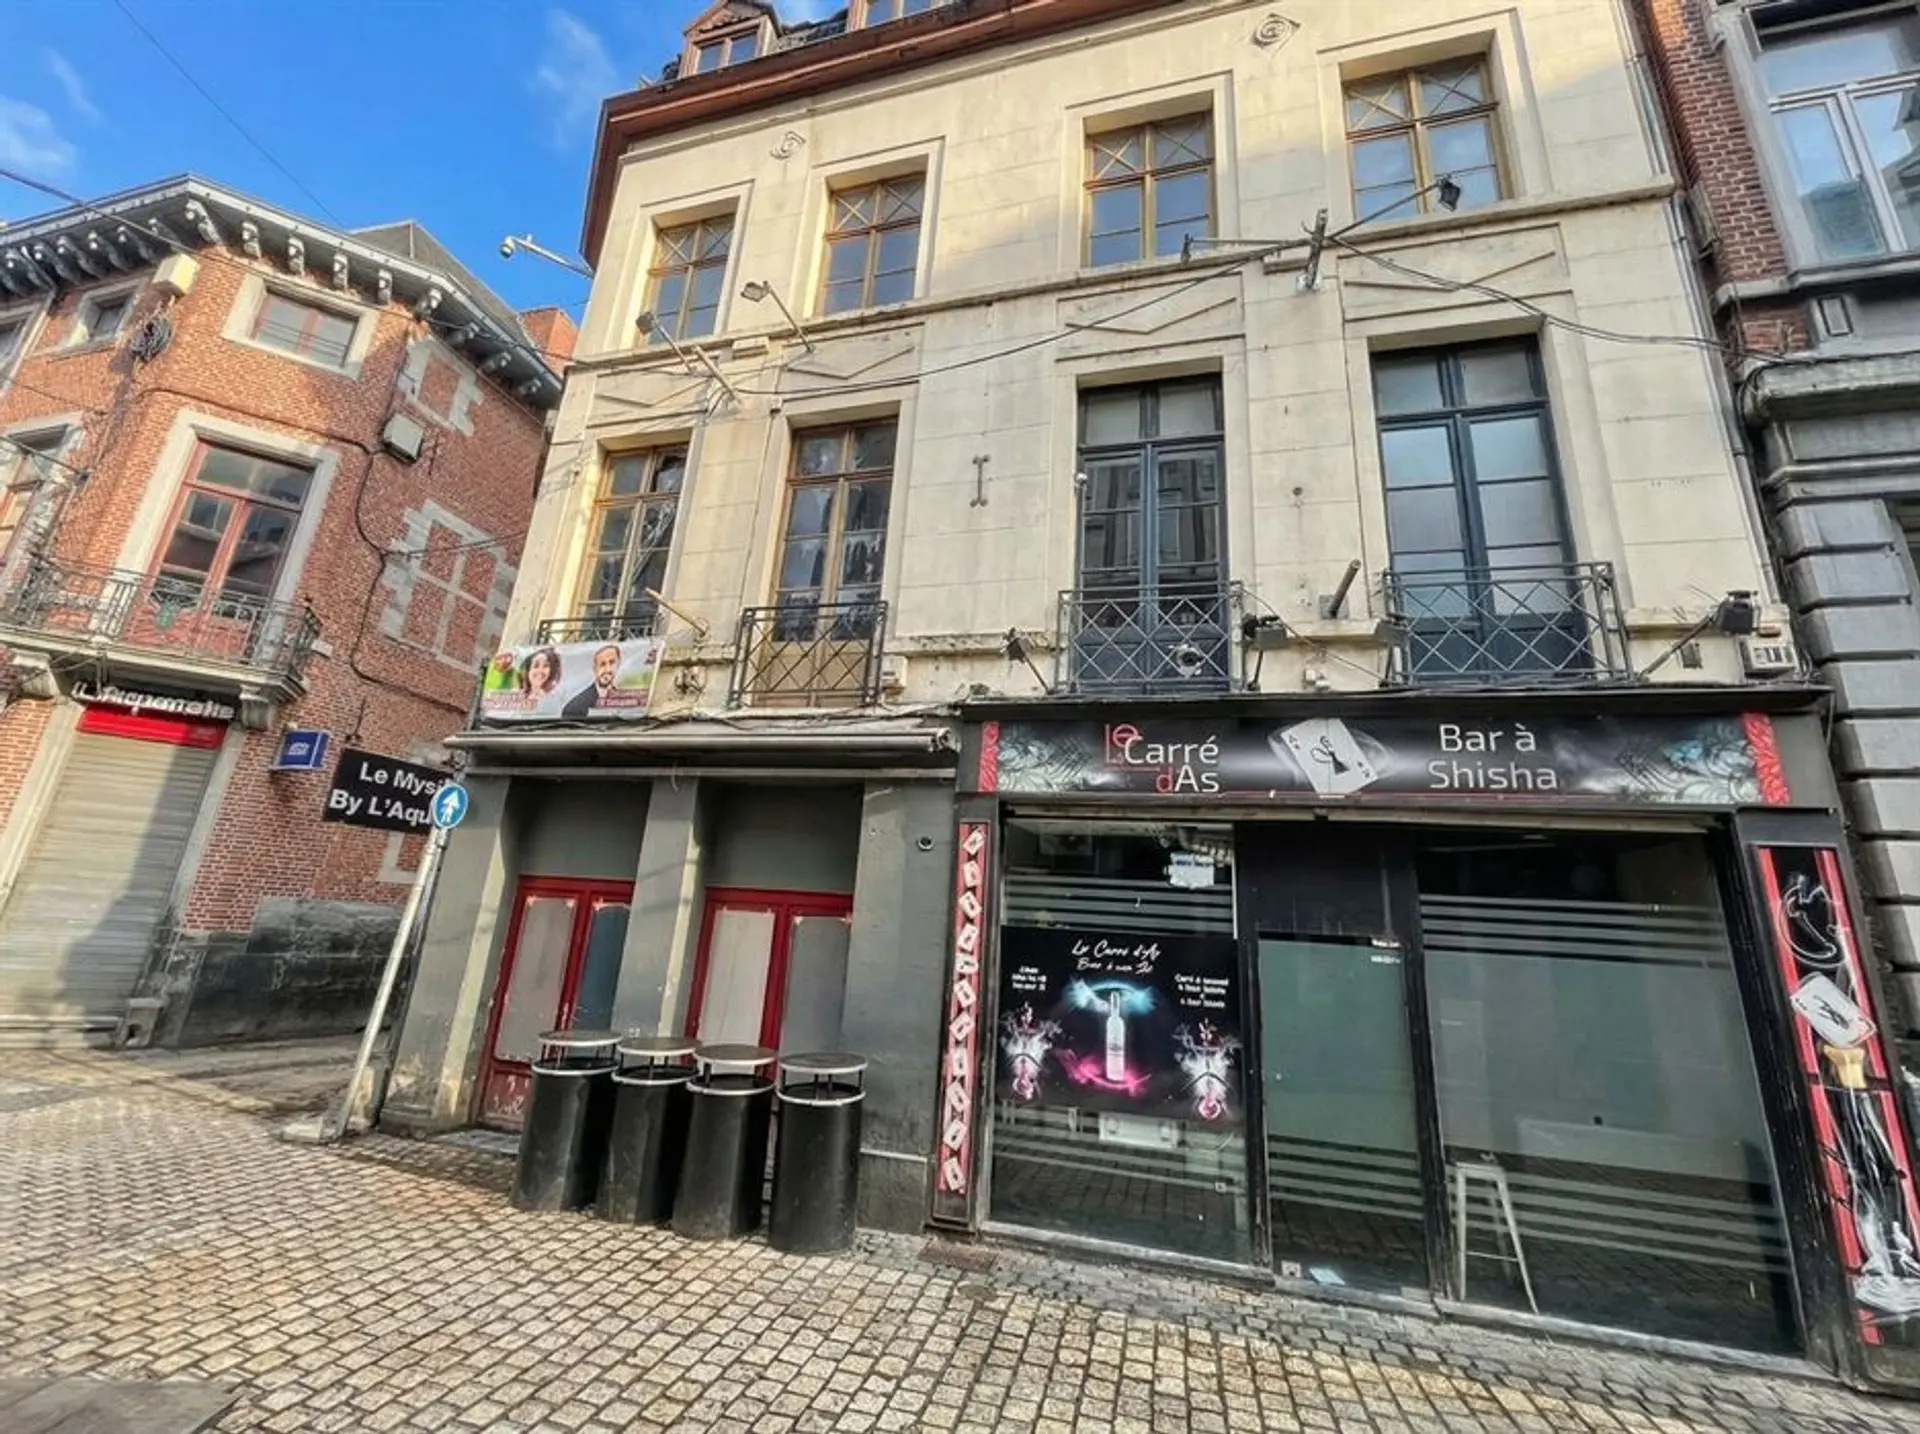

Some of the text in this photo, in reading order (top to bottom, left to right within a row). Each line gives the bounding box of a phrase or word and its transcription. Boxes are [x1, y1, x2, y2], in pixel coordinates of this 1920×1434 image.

[1124, 735, 1220, 764] Carré
[1439, 723, 1537, 752] Bar à
[359, 761, 389, 784] Le
[1428, 760, 1558, 790] Shisha
[329, 788, 363, 815] By
